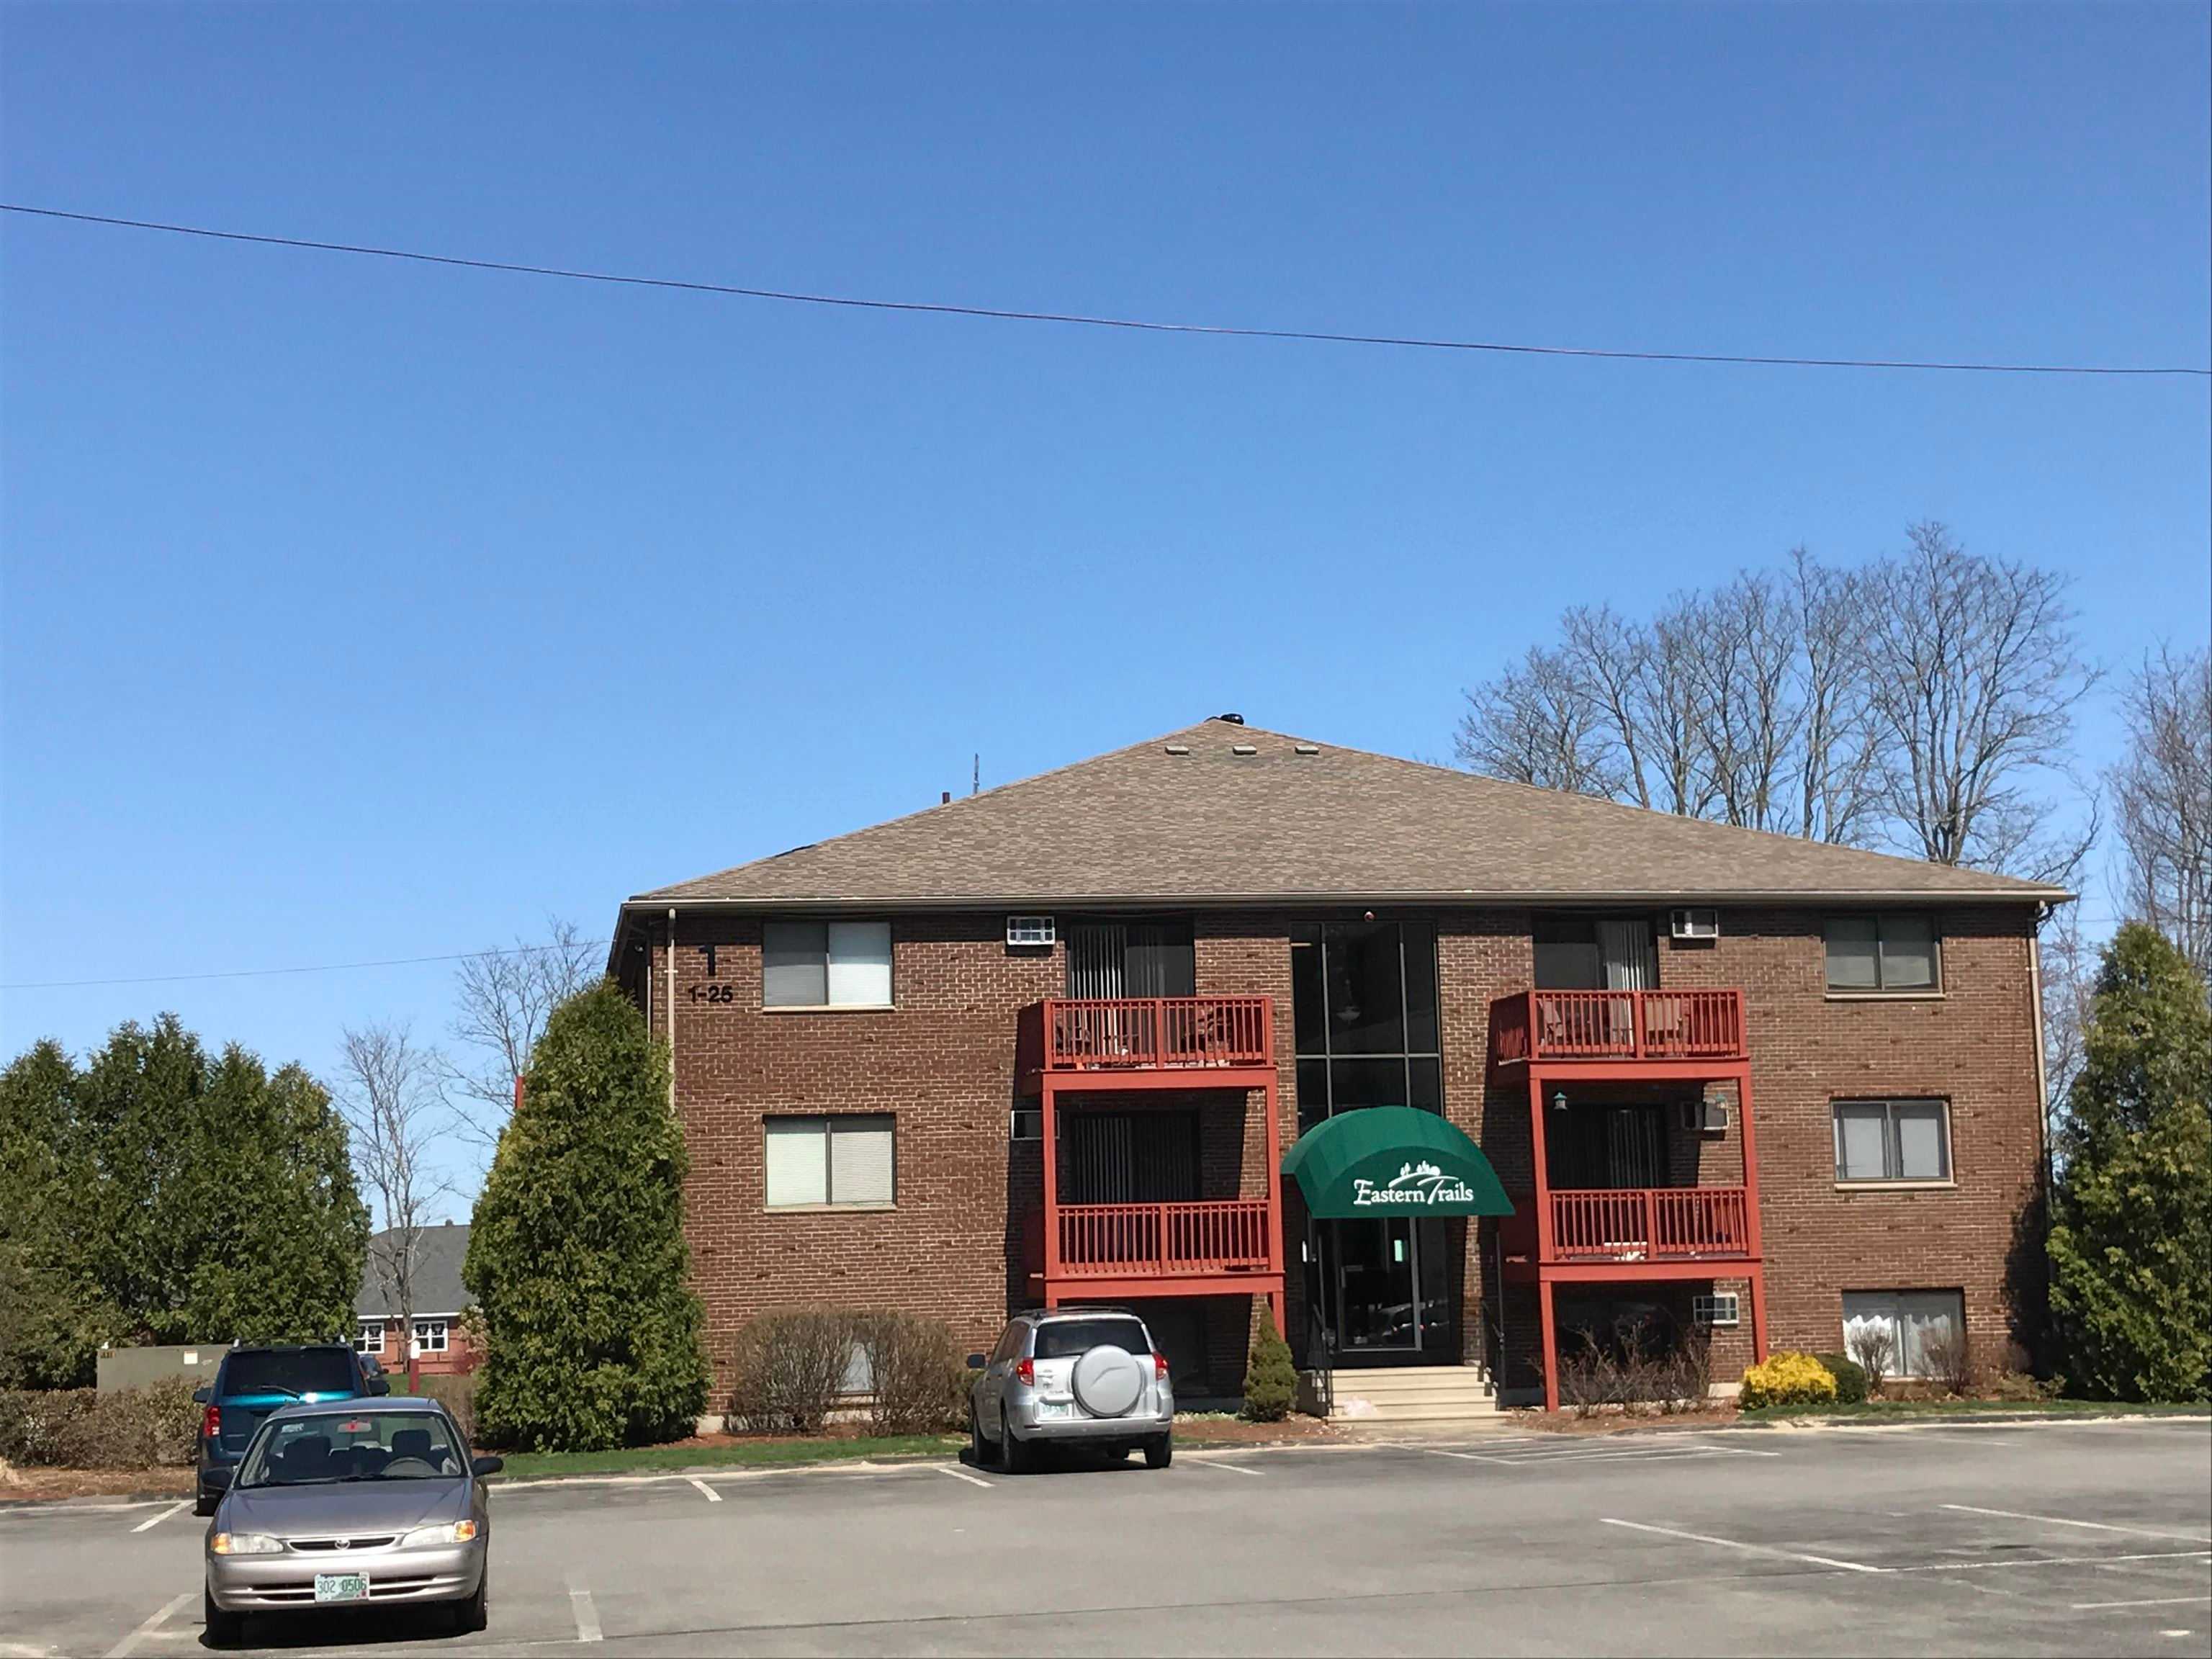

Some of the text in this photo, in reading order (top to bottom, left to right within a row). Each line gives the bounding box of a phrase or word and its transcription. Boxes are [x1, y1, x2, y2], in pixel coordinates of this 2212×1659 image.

[697, 945, 716, 976] 1
[688, 985, 734, 1003] 1-25
[1353, 1175, 1475, 1205] Eastern Trails
[317, 1578, 367, 1594] 302 0506
